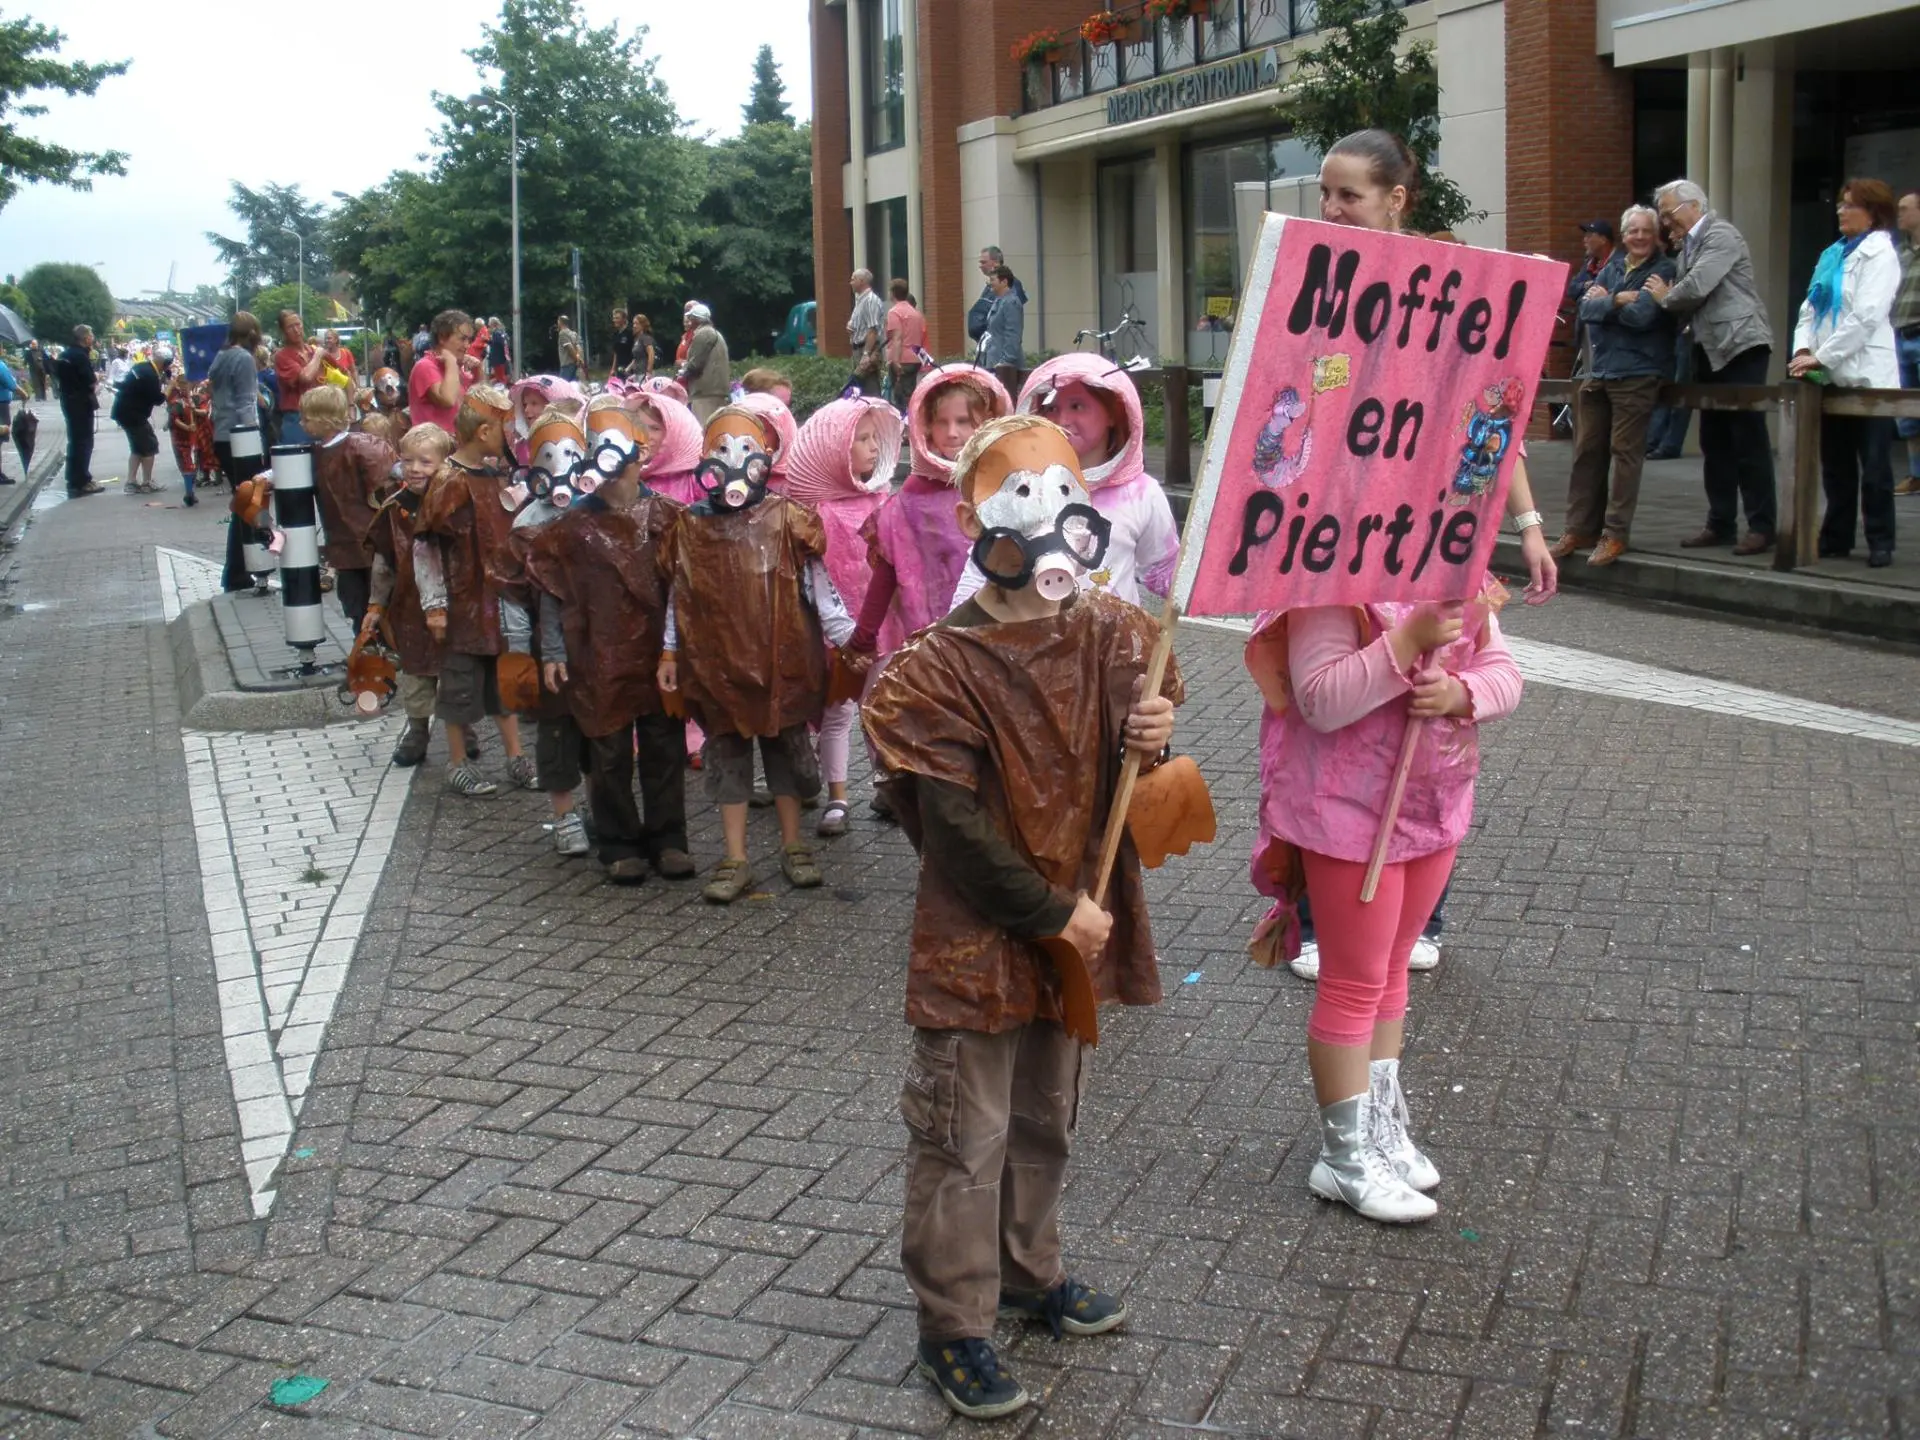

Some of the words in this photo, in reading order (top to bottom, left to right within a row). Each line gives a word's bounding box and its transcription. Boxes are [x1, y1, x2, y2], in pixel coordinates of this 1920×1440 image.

[1107, 80, 1171, 124] MEDISCH
[1174, 57, 1257, 108] CENTRUM
[1287, 243, 1528, 360] Moffel
[1347, 397, 1424, 461] en
[1228, 488, 1478, 583] Piertje
